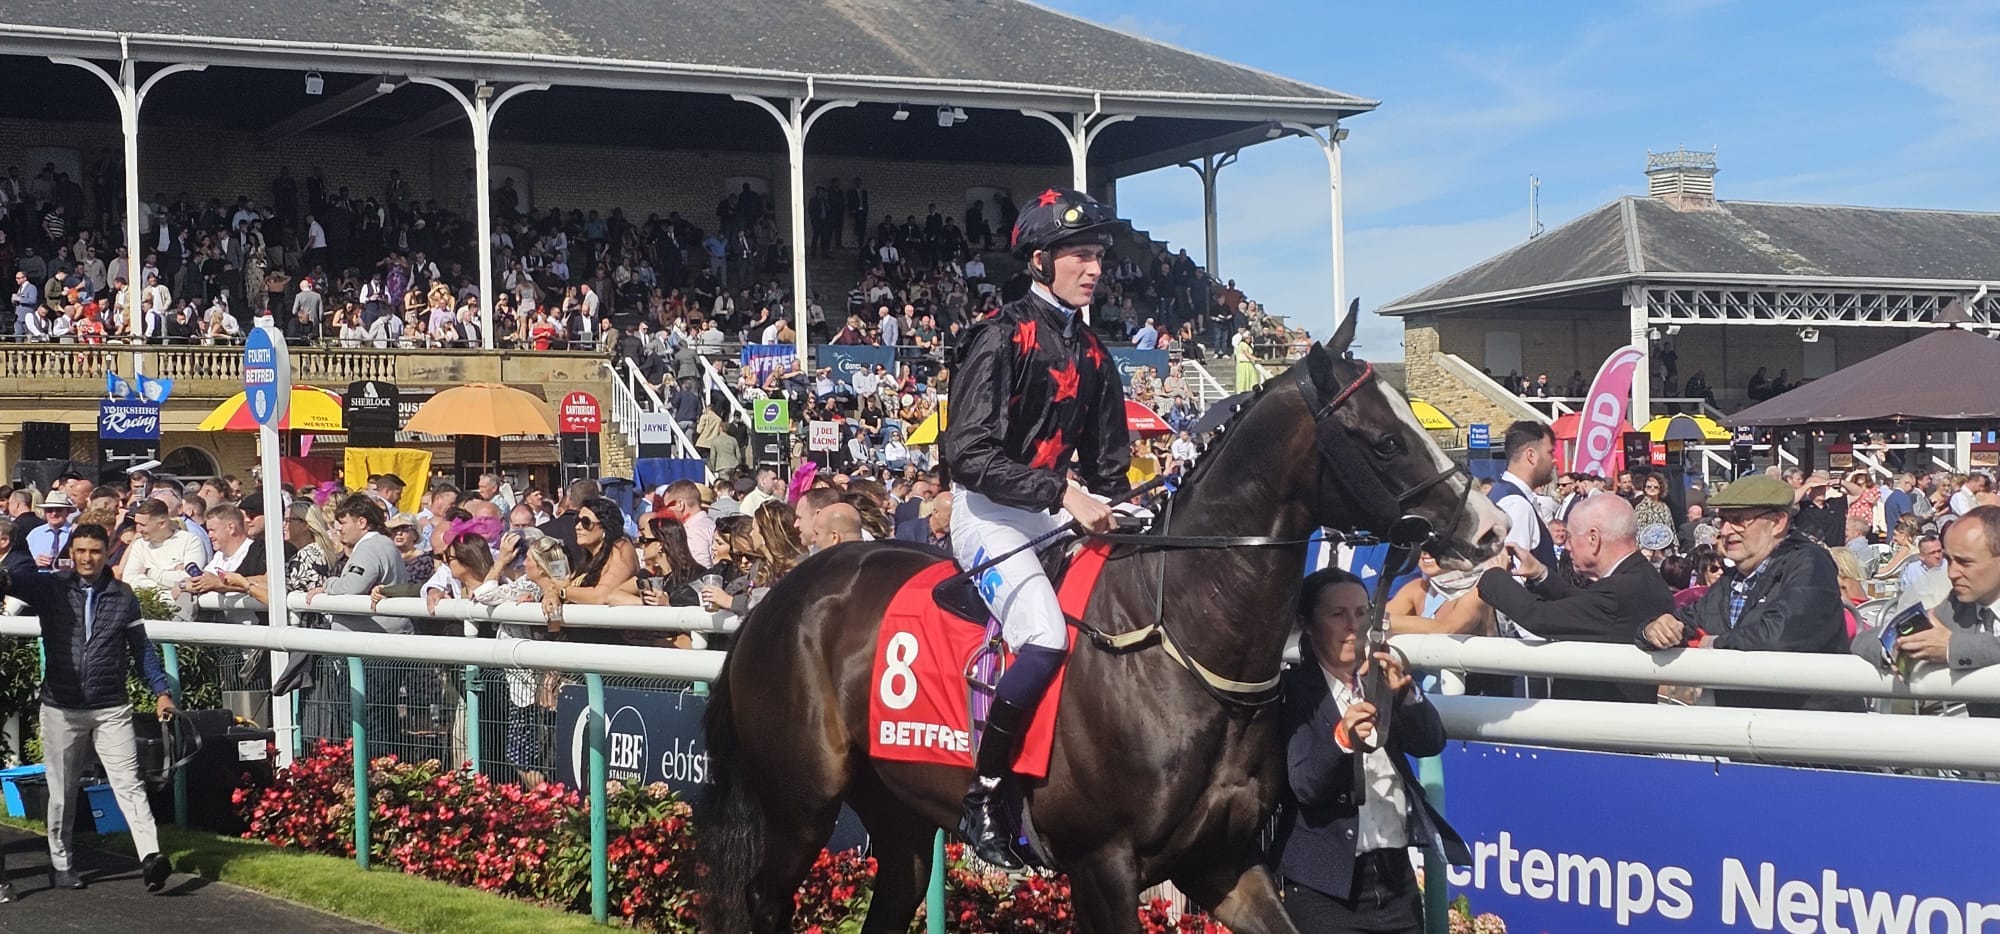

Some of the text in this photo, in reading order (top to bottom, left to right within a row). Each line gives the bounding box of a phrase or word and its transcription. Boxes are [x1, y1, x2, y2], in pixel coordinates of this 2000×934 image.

[248, 348, 271, 363] FOURTH
[245, 368, 275, 383] BETFRED
[351, 398, 391, 407] SHERLOCK
[103, 405, 159, 415] YORKSHIRE
[565, 405, 596, 416] CARTWRIGHT
[102, 413, 158, 433] Racing
[642, 423, 669, 433] JAYNE
[816, 427, 820, 437] J
[812, 437, 837, 446] RACING
[880, 631, 919, 710] 8
[610, 732, 644, 769] EBF
[661, 737, 715, 784] ebfst
[608, 769, 641, 782] STALLIONS
